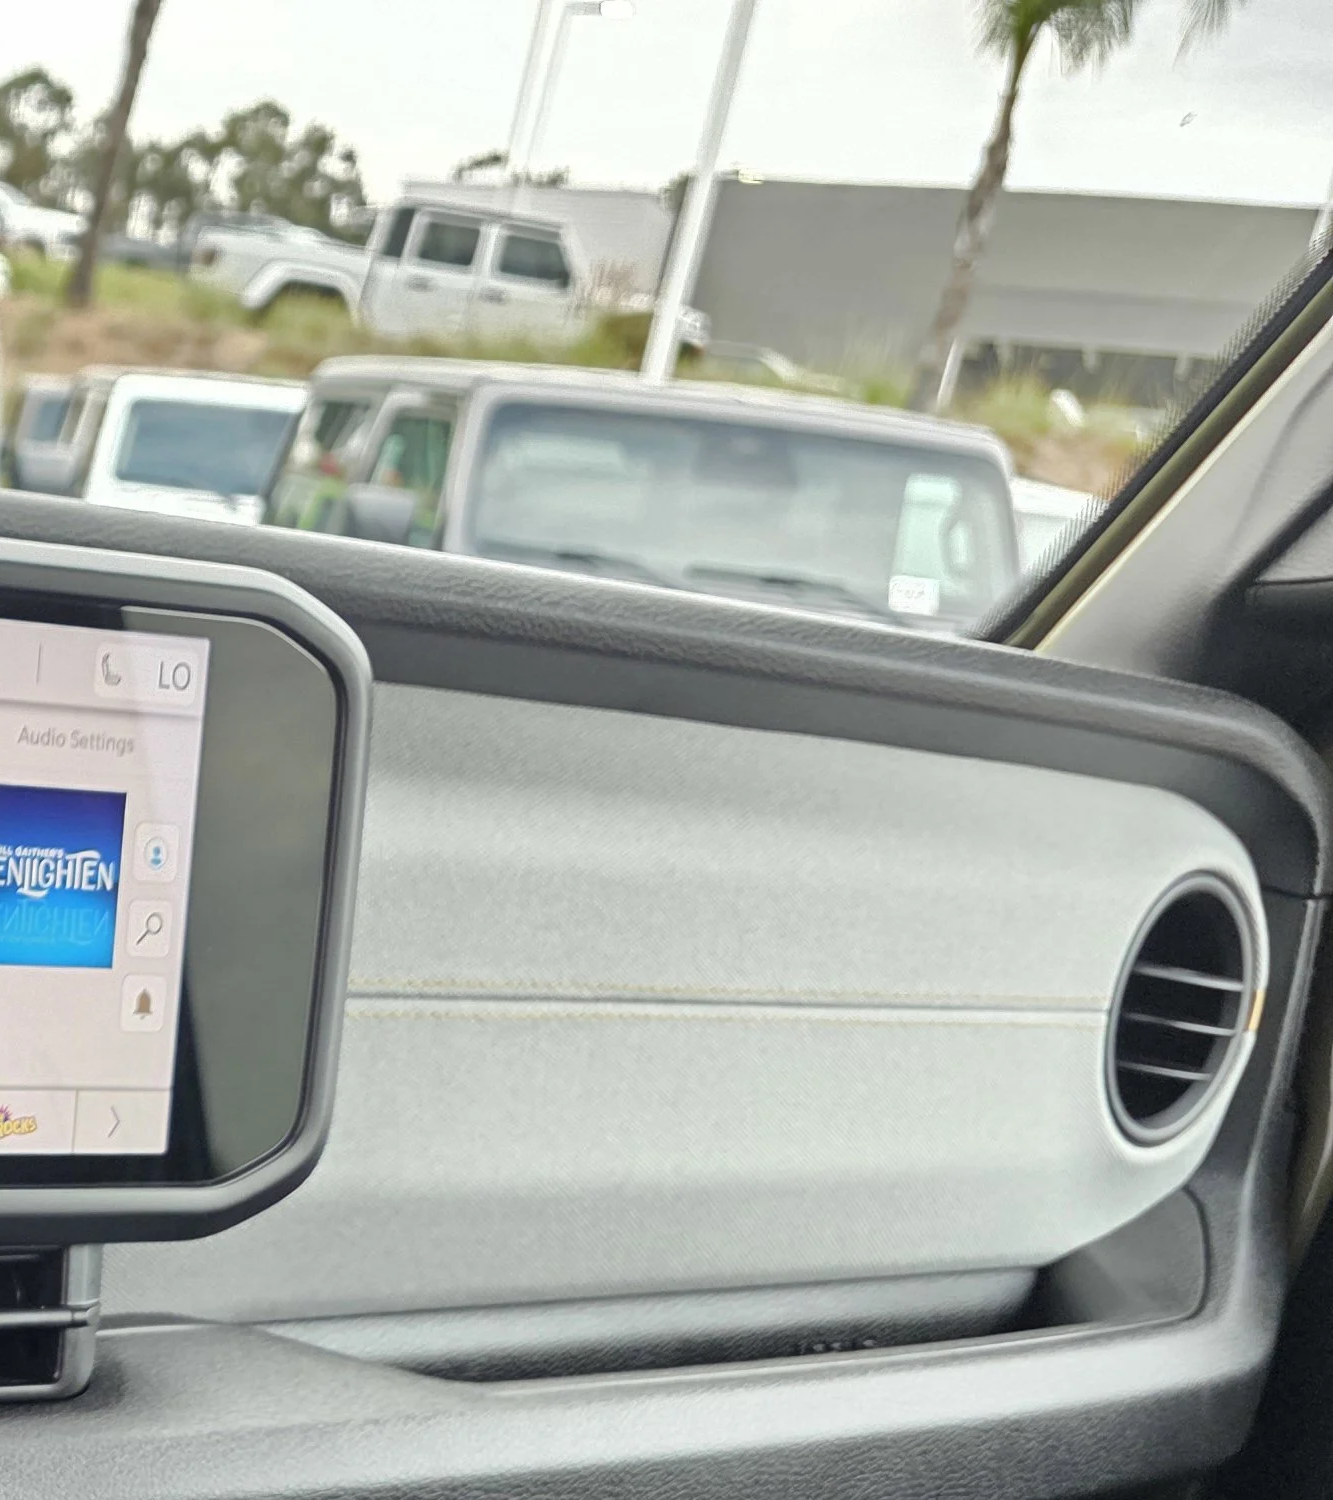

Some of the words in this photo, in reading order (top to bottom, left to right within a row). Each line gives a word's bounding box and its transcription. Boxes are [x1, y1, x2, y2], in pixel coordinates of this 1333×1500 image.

[158, 662, 191, 691] LO
[17, 725, 66, 750] Audio
[70, 730, 135, 758] Settings
